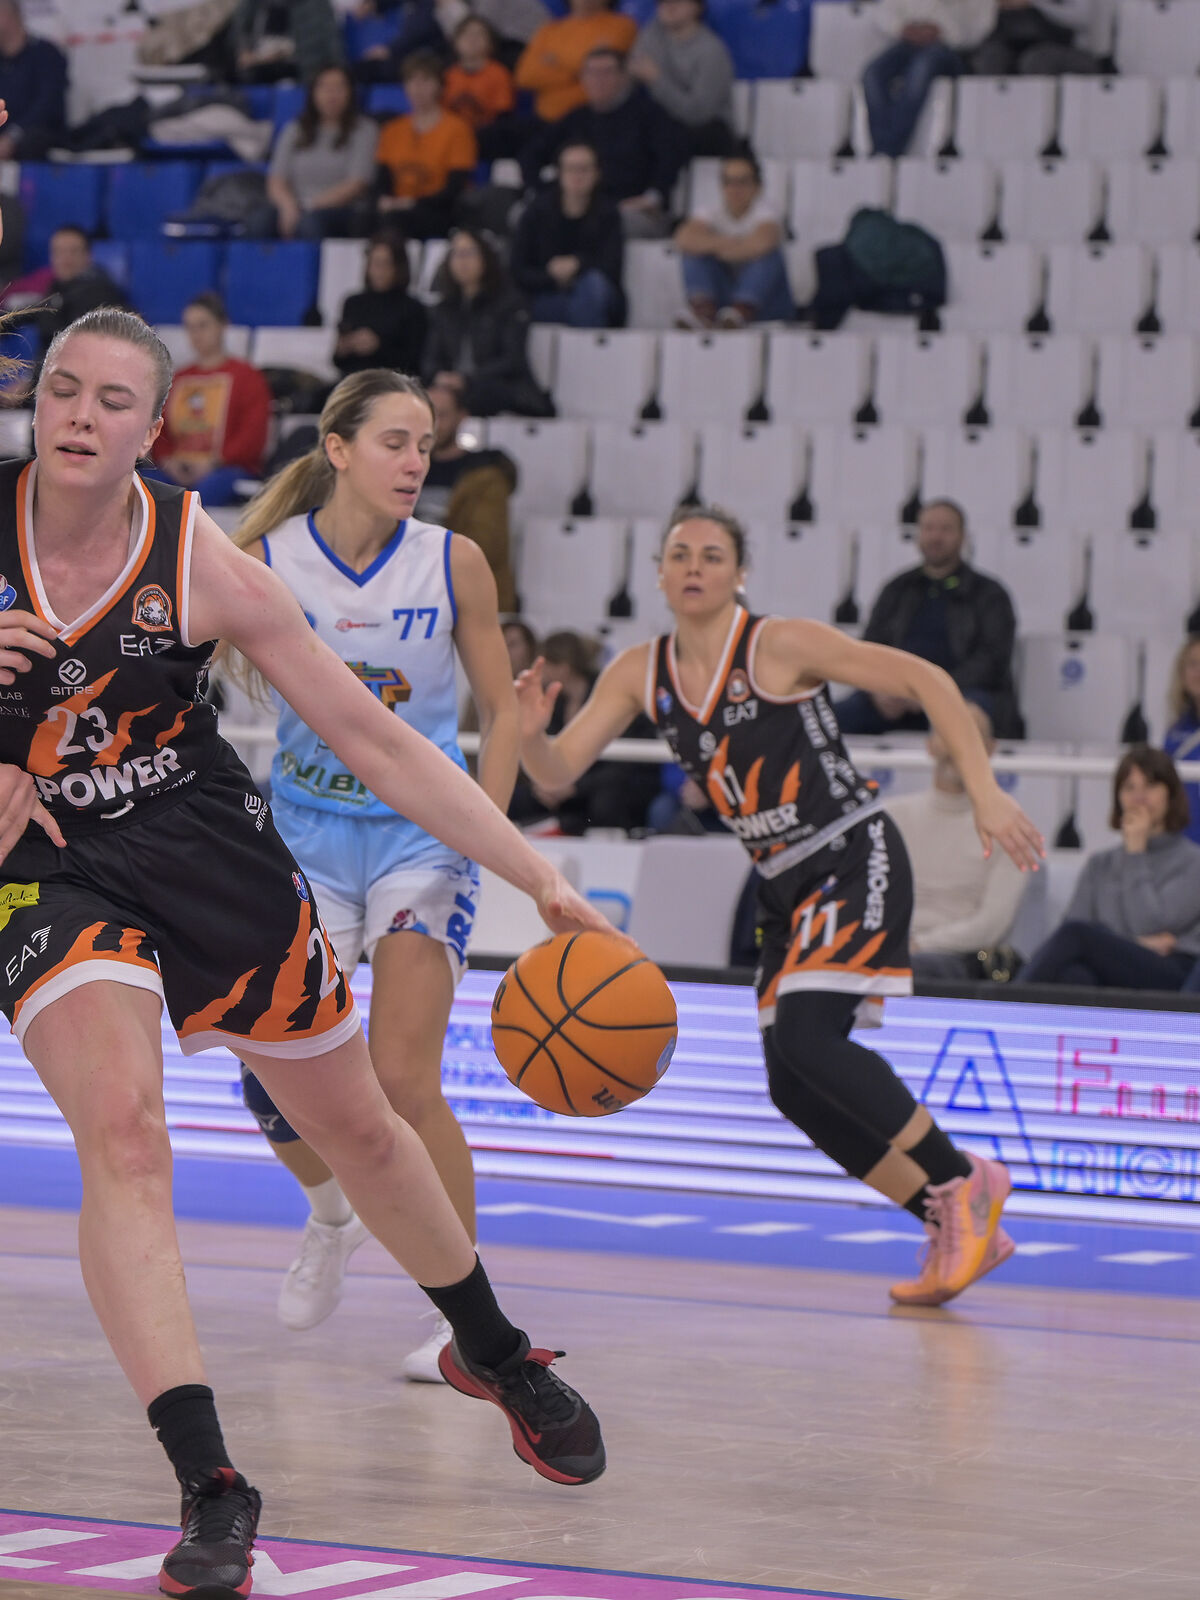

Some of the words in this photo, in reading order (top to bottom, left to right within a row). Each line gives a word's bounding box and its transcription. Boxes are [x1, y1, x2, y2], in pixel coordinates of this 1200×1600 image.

[392, 607, 438, 640] 77
[120, 634, 176, 656] EA7
[51, 685, 95, 695] BITRE
[47, 705, 114, 756] 23
[723, 699, 759, 726] EA7
[34, 747, 182, 807] POWER
[711, 764, 747, 806] 11
[800, 901, 838, 949] 11
[6, 925, 52, 986] EA7
